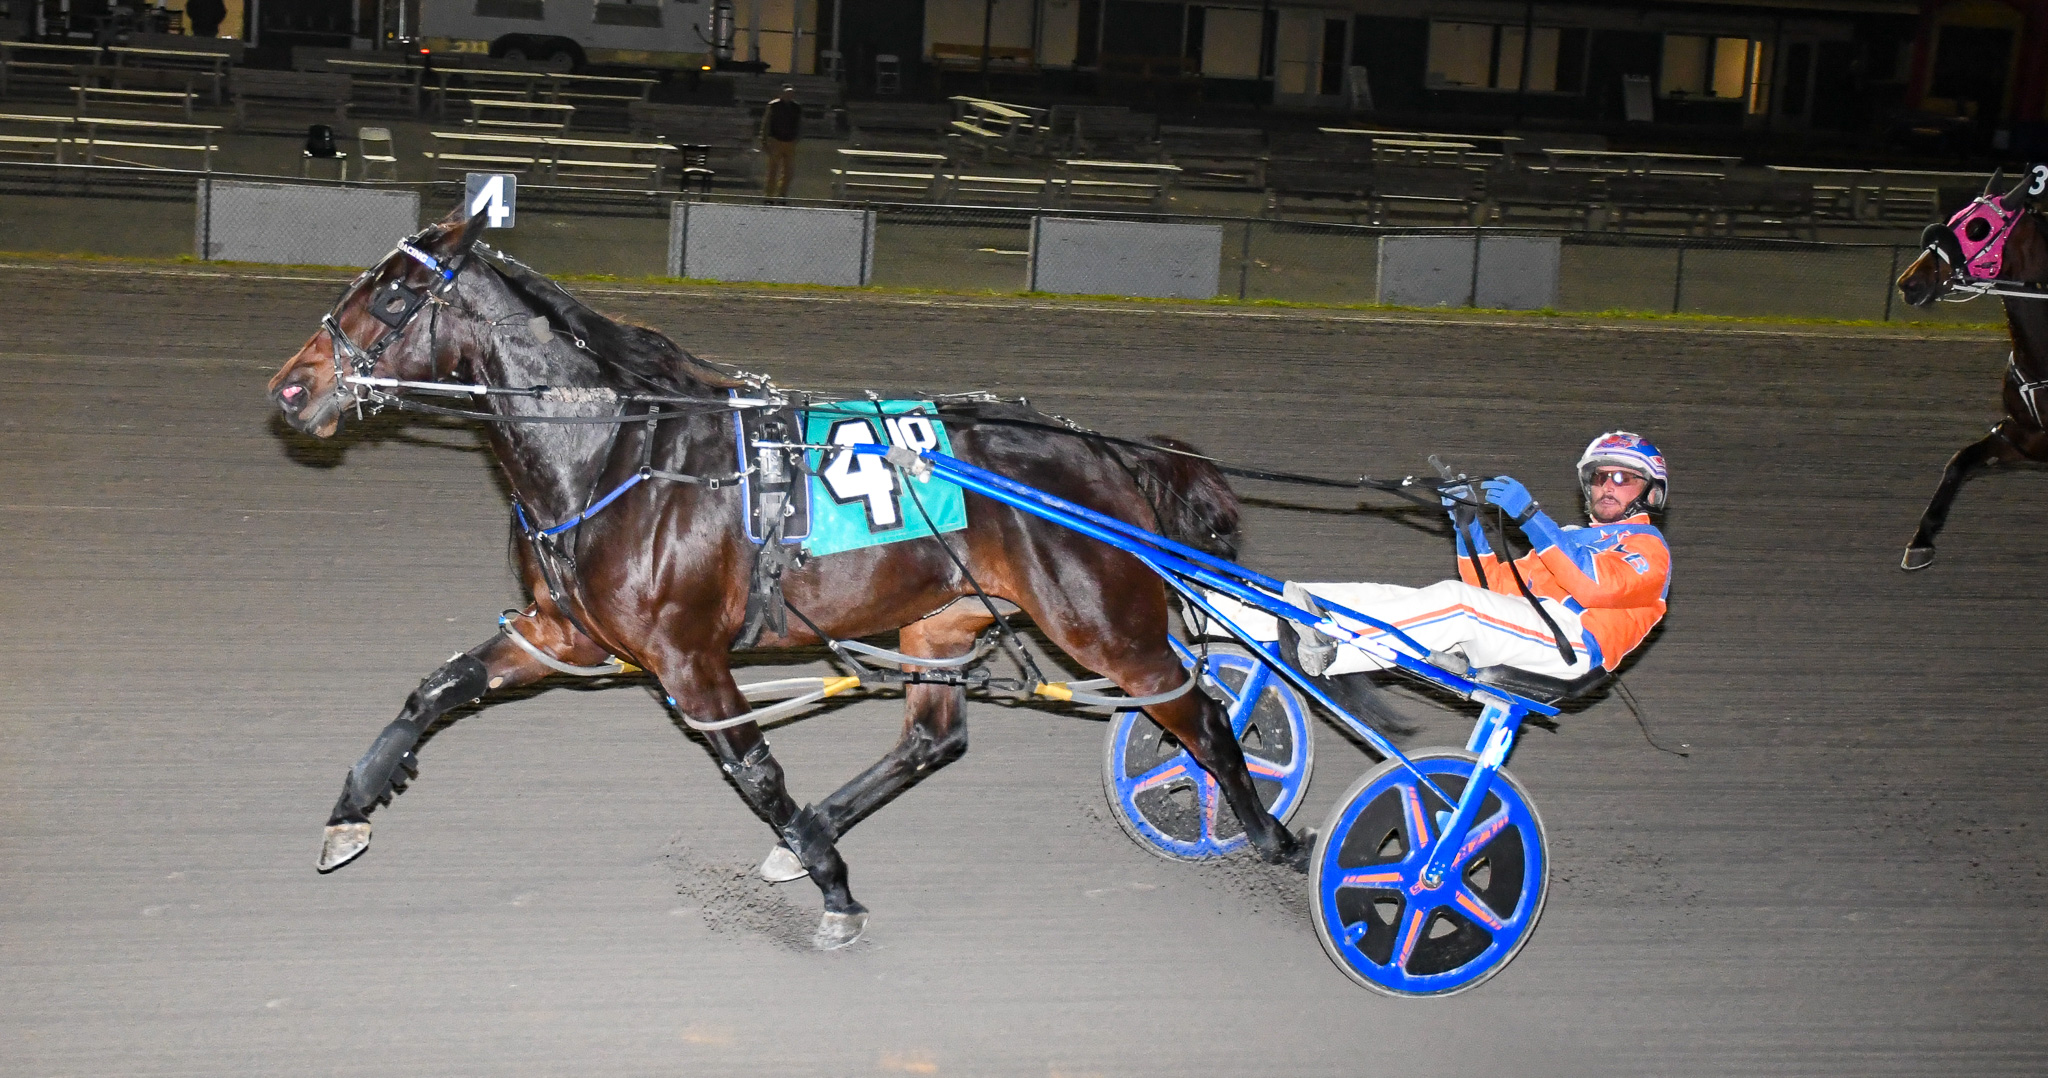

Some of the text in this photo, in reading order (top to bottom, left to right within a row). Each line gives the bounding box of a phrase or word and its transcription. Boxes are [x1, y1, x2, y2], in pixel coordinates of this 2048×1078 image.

[471, 175, 510, 228] 4
[2028, 165, 2048, 195] 3
[822, 419, 898, 528] 4
